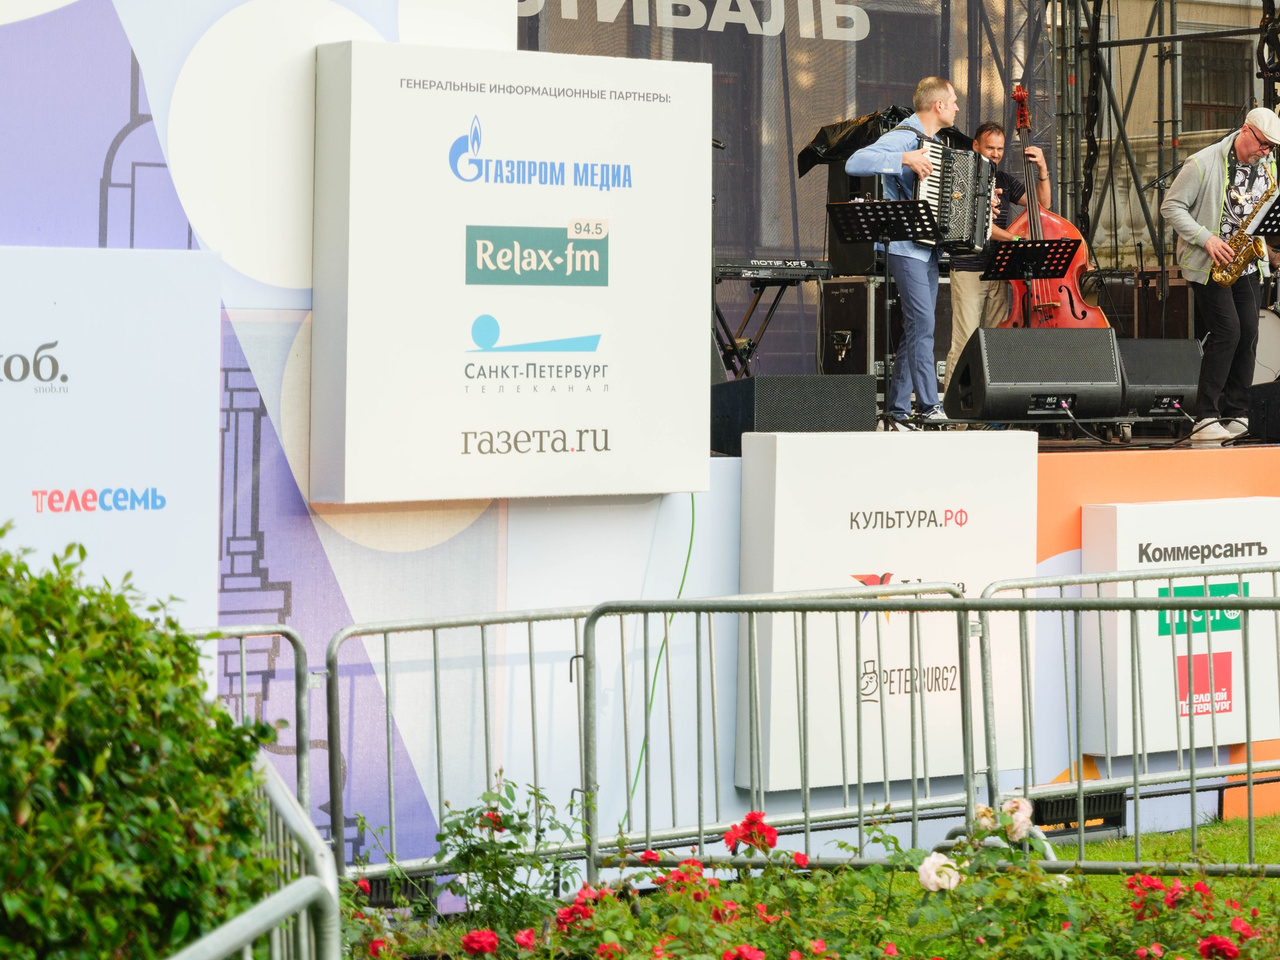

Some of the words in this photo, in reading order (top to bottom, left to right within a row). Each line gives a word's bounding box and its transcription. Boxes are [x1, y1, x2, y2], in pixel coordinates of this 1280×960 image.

[400, 78, 487, 94] ГЕНЕРАЛЬНЫЕ
[489, 83, 607, 100] ИНФОРМАЦИОННЫЕ
[608, 90, 672, 103] ПАРТНЕРЫ:
[484, 158, 565, 186] ГАЗПРОМ
[573, 162, 632, 191] МЕДИА
[574, 222, 603, 235] 94.5
[0, 340, 69, 383] об.
[34, 383, 69, 394] snob.ru
[461, 428, 611, 455] газета.ru
[850, 509, 968, 530] КУЛЬТУРА.РФ
[1138, 542, 1268, 564] Коммерсантъ
